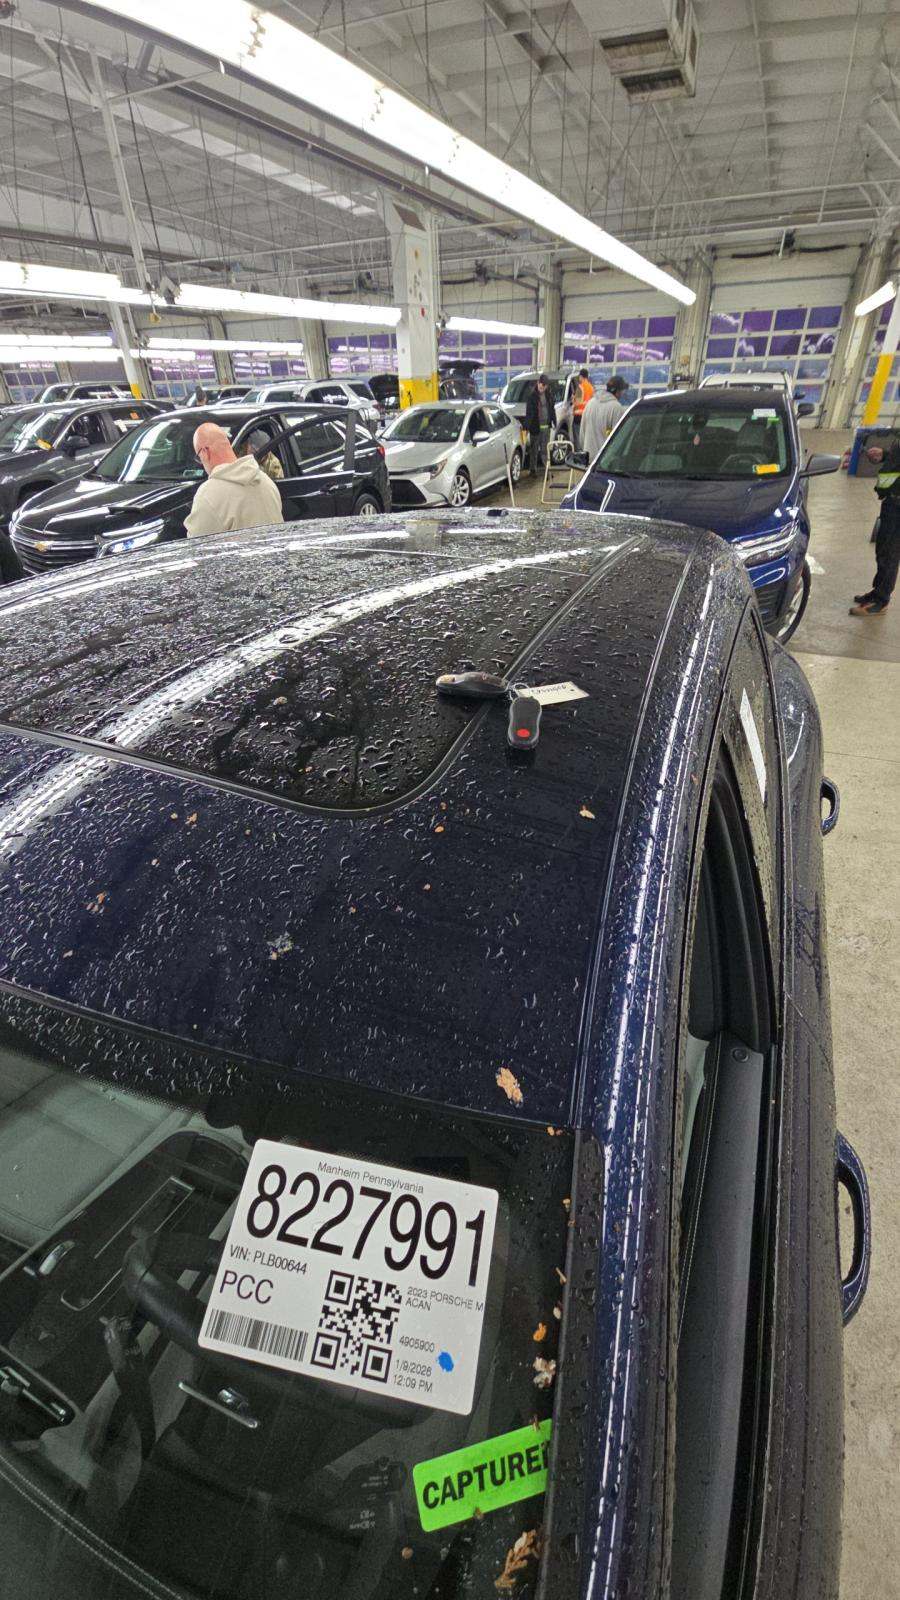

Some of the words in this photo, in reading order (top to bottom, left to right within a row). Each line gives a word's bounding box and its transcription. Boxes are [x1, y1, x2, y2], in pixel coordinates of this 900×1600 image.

[317, 1161, 360, 1180] Manheim
[362, 1171, 424, 1194] Pennsylvania
[246, 1164, 486, 1287] 8227991
[230, 1244, 251, 1261] VIN:
[253, 1250, 308, 1275] PLB00644
[219, 1270, 274, 1304] PCC
[407, 1286, 428, 1299] 2023
[430, 1290, 474, 1310] PORSCHE
[475, 1302, 484, 1313] M
[405, 1297, 432, 1311] ACAN
[393, 1374, 416, 1389] 12:09
[419, 1379, 433, 1393] PM
